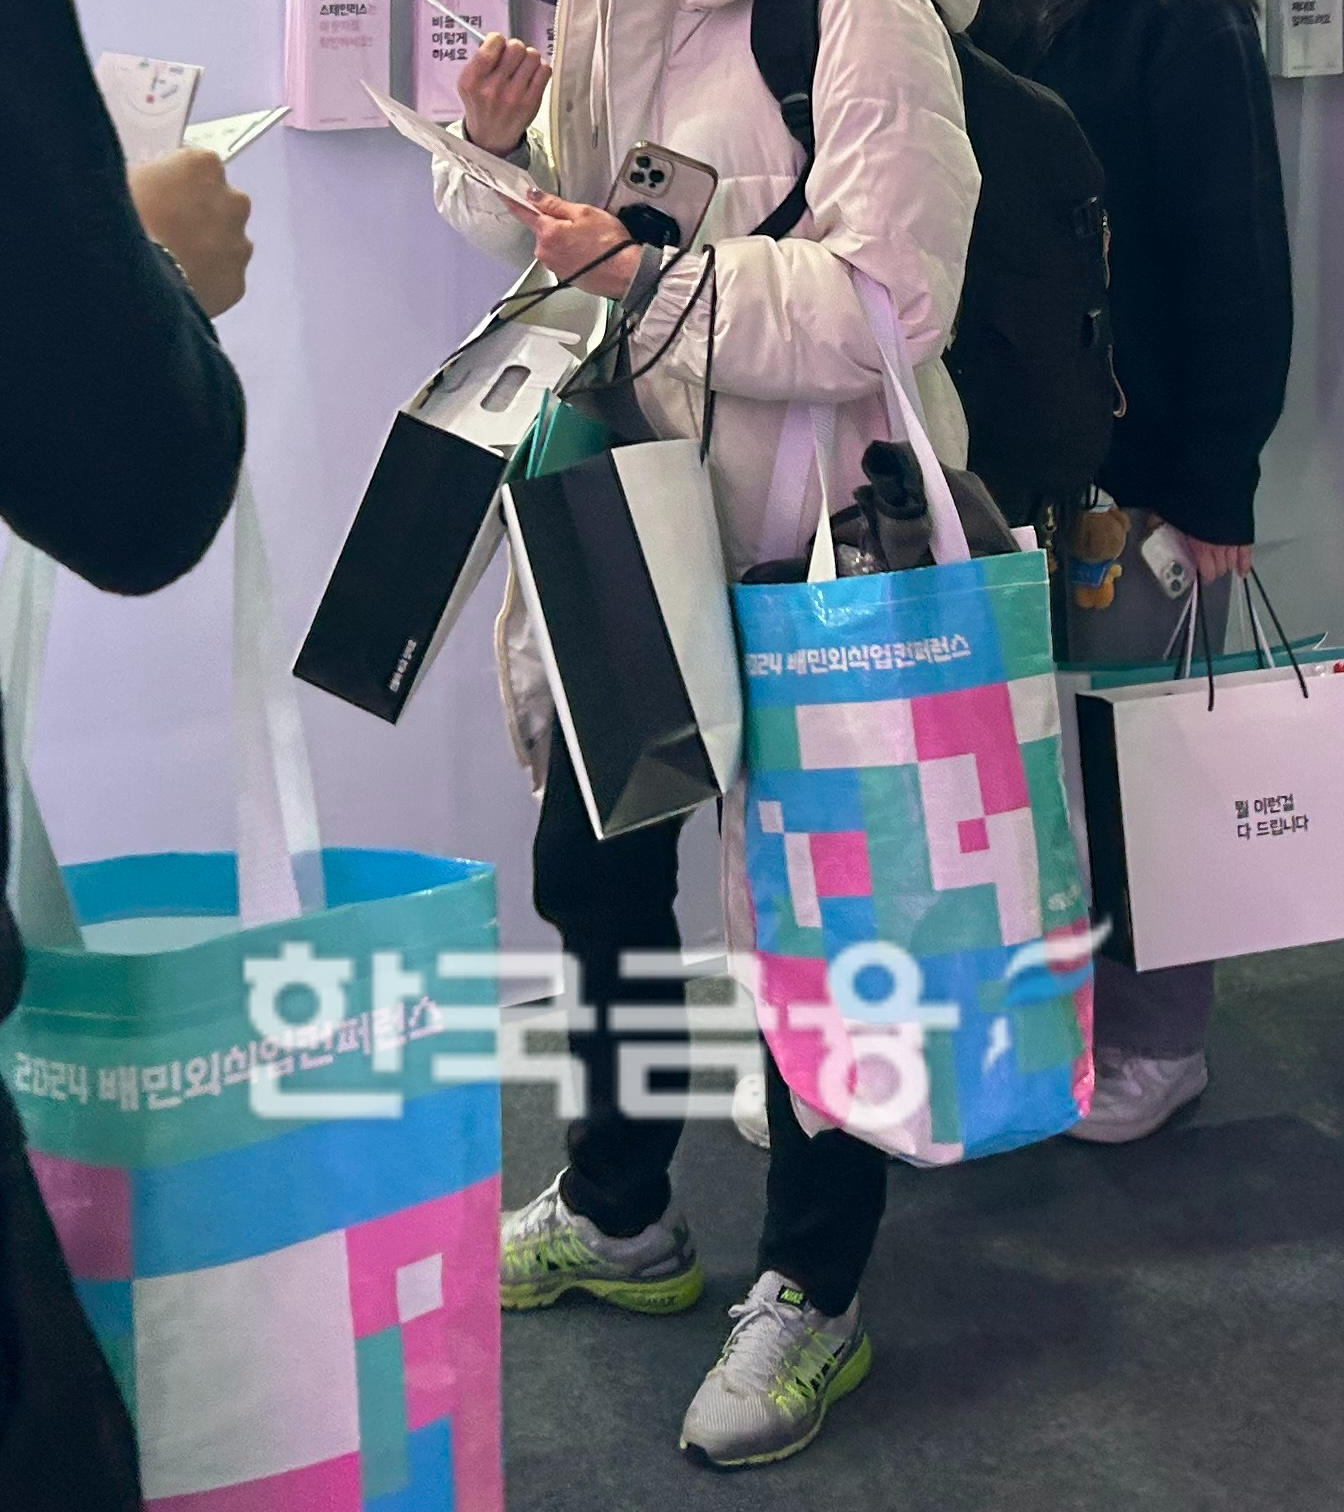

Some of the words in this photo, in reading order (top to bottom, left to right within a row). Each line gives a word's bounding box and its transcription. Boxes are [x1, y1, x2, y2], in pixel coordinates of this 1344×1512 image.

[432, 32, 468, 46] 이렇게
[432, 48, 468, 62] 하세요
[786, 633, 973, 675] 배민외식업컨퍼런스
[1253, 792, 1295, 815] 이런걸
[1236, 822, 1252, 841] 다
[1256, 813, 1310, 836] 드립니다
